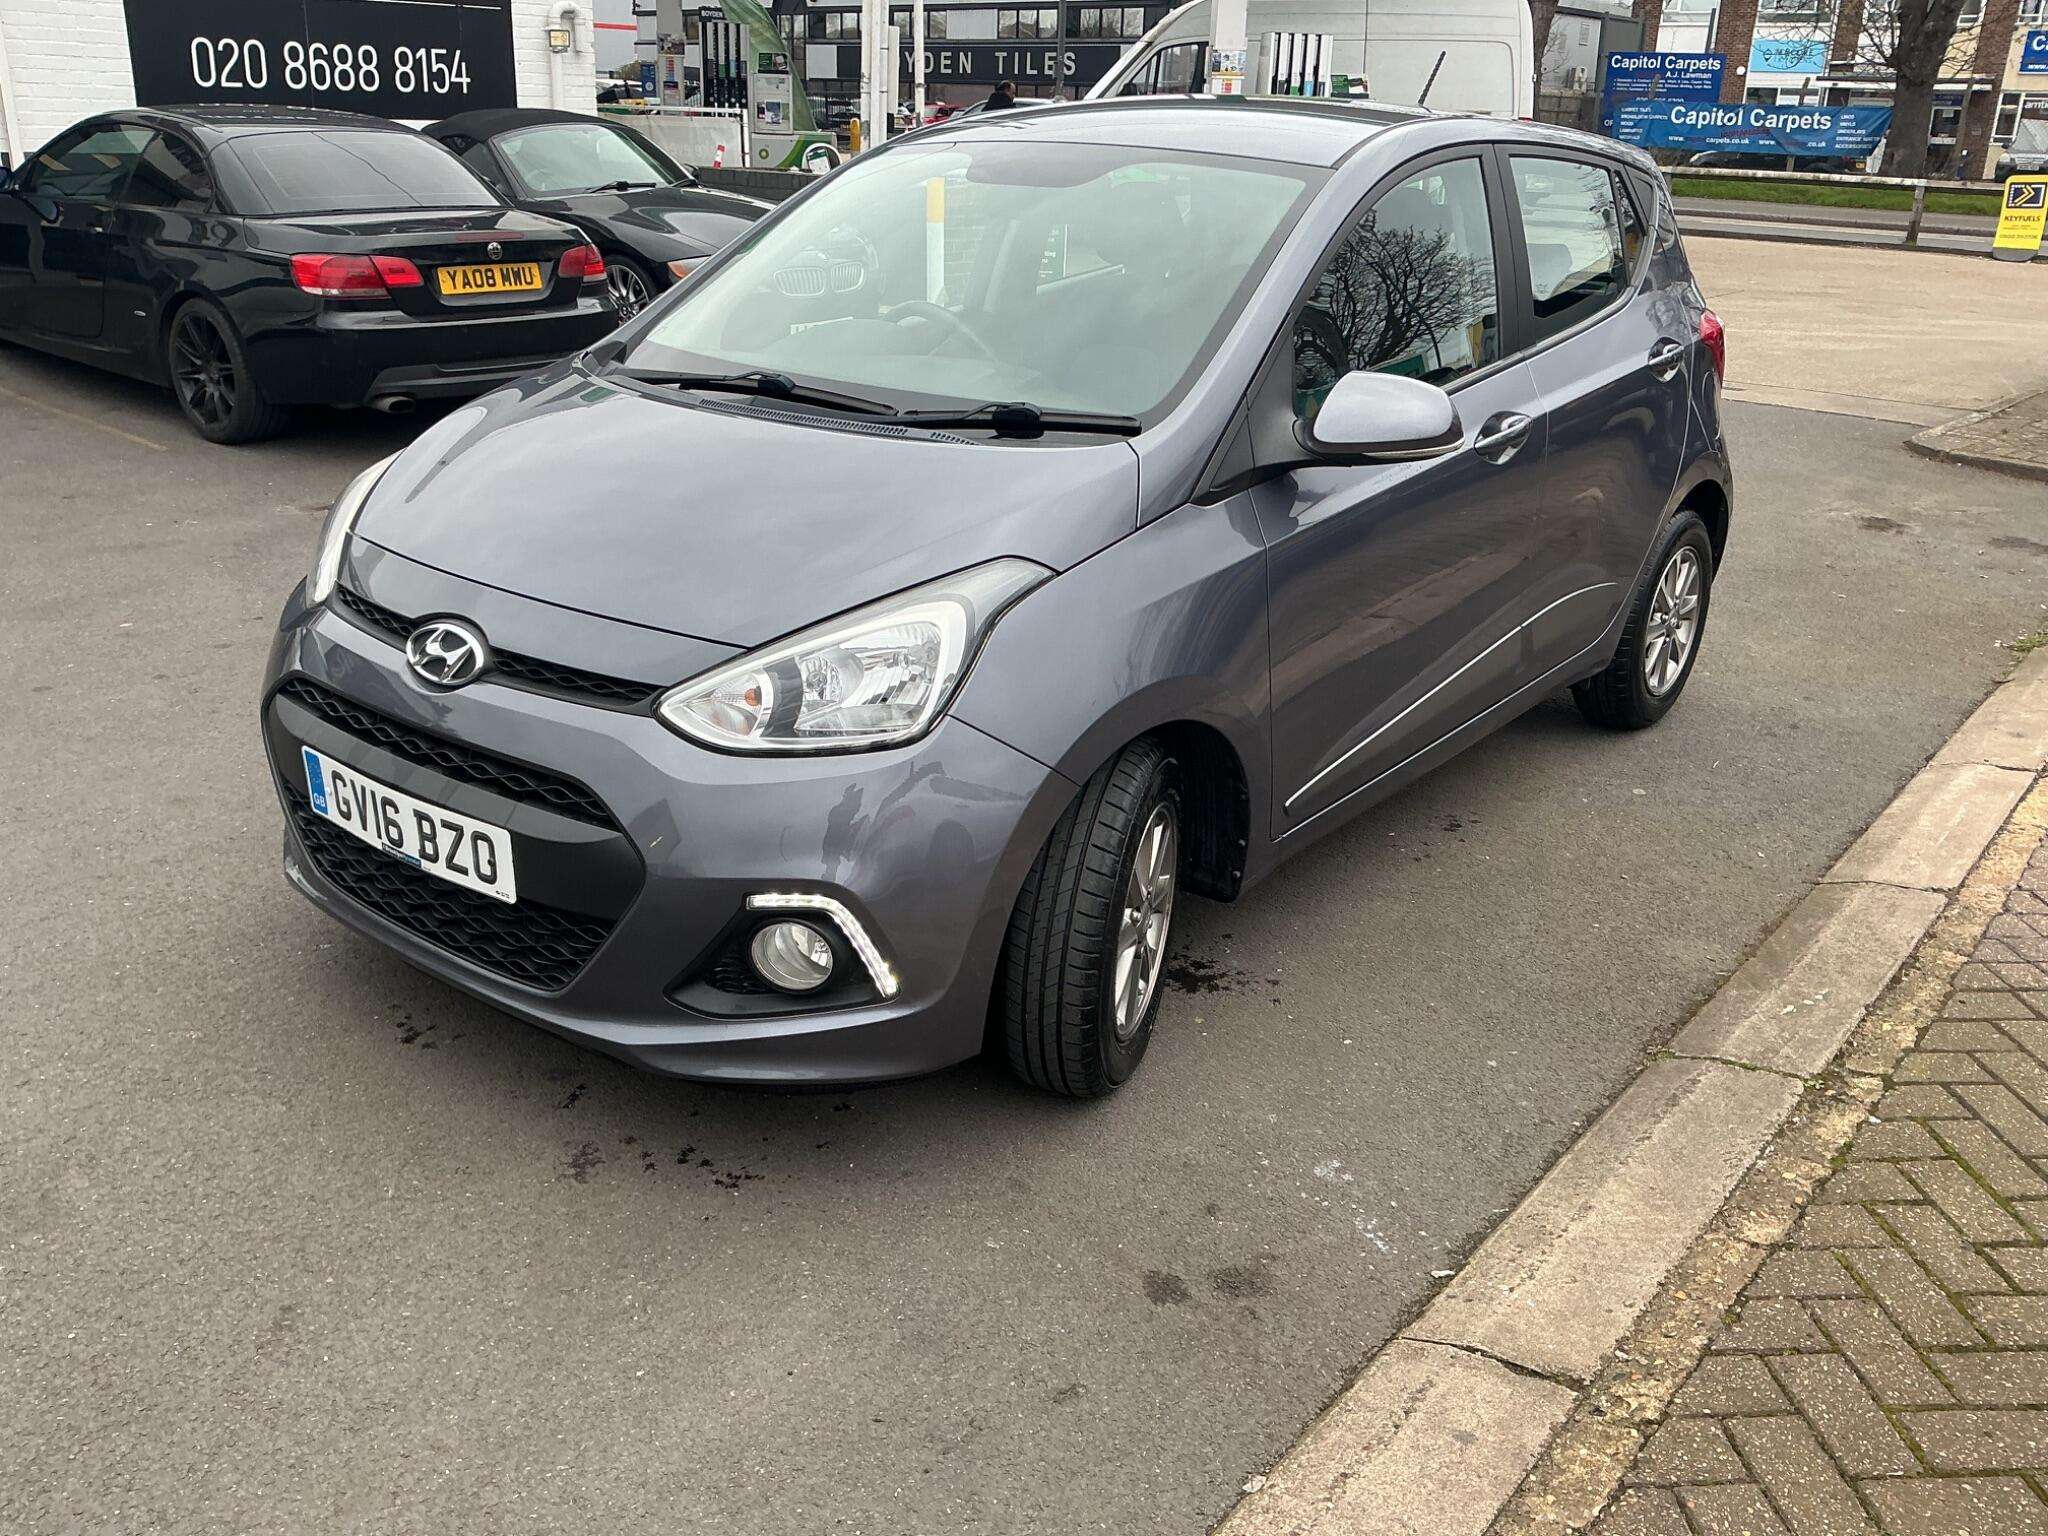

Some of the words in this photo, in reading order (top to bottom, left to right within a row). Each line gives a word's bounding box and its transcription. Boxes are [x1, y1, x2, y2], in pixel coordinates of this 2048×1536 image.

[189, 36, 268, 89] 020
[283, 40, 380, 93] 8688
[393, 46, 472, 94] 8154
[905, 51, 972, 74] YDEN
[995, 51, 1077, 75] TILES
[1611, 54, 1661, 71] Capitol
[1664, 55, 1721, 72] Carpets
[1681, 71, 1712, 79] Lawman
[1671, 106, 1743, 129] Capitol
[1749, 109, 1832, 133] Carpets
[446, 266, 497, 290] YA08
[499, 264, 535, 286] MWU
[313, 792, 326, 807] GB
[331, 769, 404, 849] GV16
[412, 808, 498, 886] BZO
